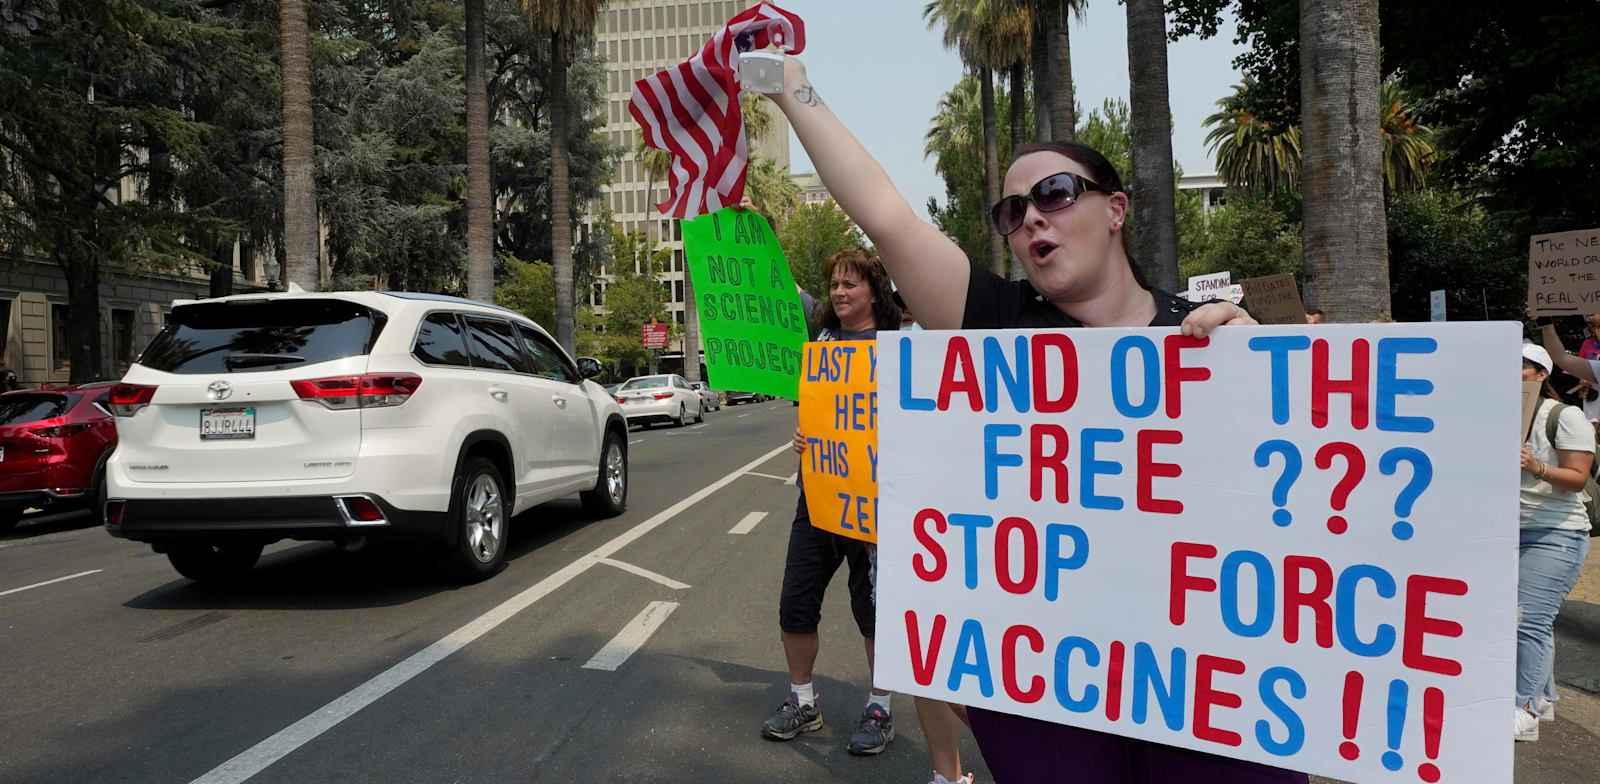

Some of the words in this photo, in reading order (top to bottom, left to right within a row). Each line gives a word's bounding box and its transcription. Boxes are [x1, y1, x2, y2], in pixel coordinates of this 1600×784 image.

[712, 212, 722, 242] I
[734, 214, 767, 245] AM
[1535, 239, 1565, 252] The
[707, 255, 756, 288] NOT
[770, 258, 785, 290] A
[1534, 257, 1580, 270] WORLD
[1540, 275, 1557, 285] IS
[1569, 273, 1596, 282] THE
[1195, 277, 1231, 292] STANDING
[1536, 291, 1575, 305] REAL
[703, 292, 804, 334] SCIENCE
[706, 337, 803, 376] PROJECT
[807, 345, 857, 384] LAST
[900, 334, 1079, 413] LAND
[1111, 333, 1211, 418] OF
[1248, 336, 1437, 432] THE
[806, 437, 849, 478] THIS
[984, 424, 1184, 514] FREE
[1254, 440, 1433, 540] ???
[913, 509, 1090, 602] STOP
[1170, 542, 1468, 677] FORCE
[905, 610, 1307, 756] VACCINES
